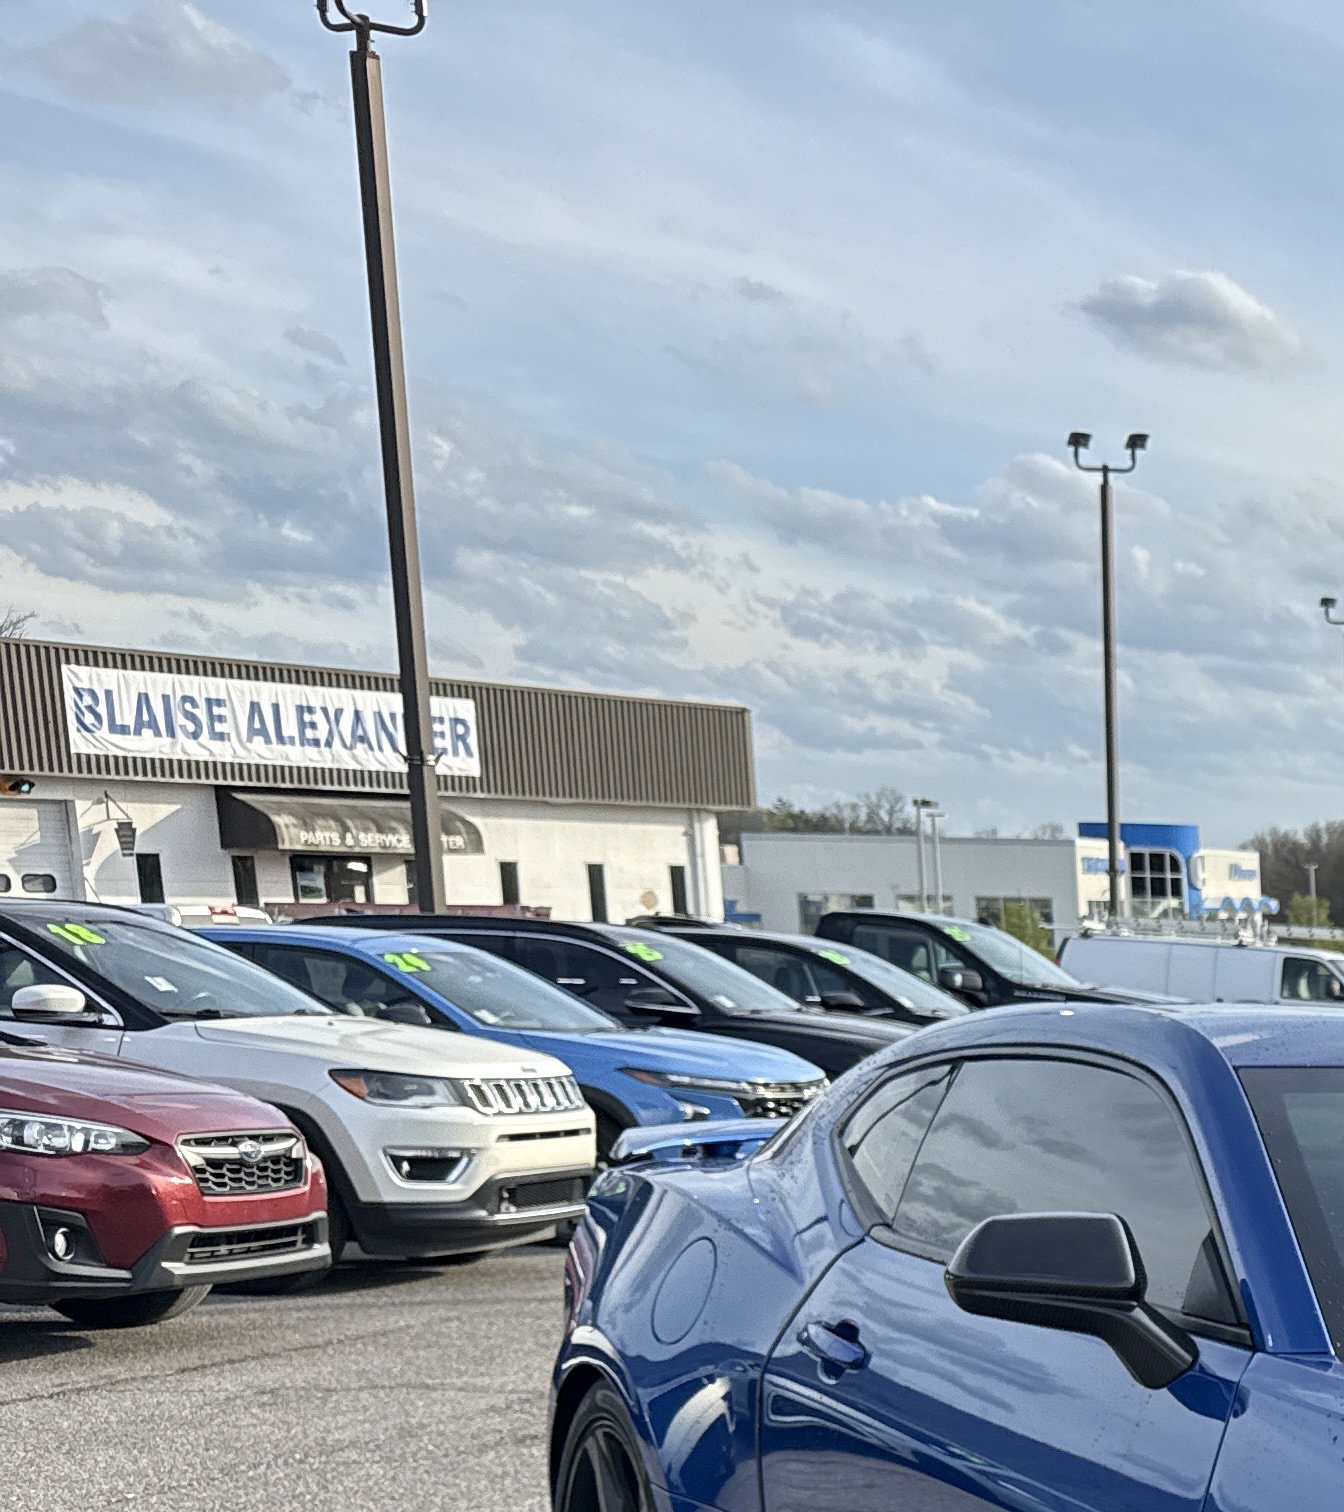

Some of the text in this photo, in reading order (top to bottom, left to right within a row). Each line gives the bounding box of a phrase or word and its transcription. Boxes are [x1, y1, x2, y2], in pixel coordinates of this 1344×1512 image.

[71, 685, 474, 759] BLAISE ALEXANER
[299, 831, 341, 847] PARTS
[345, 832, 355, 847] &
[358, 832, 412, 849] SERVICE
